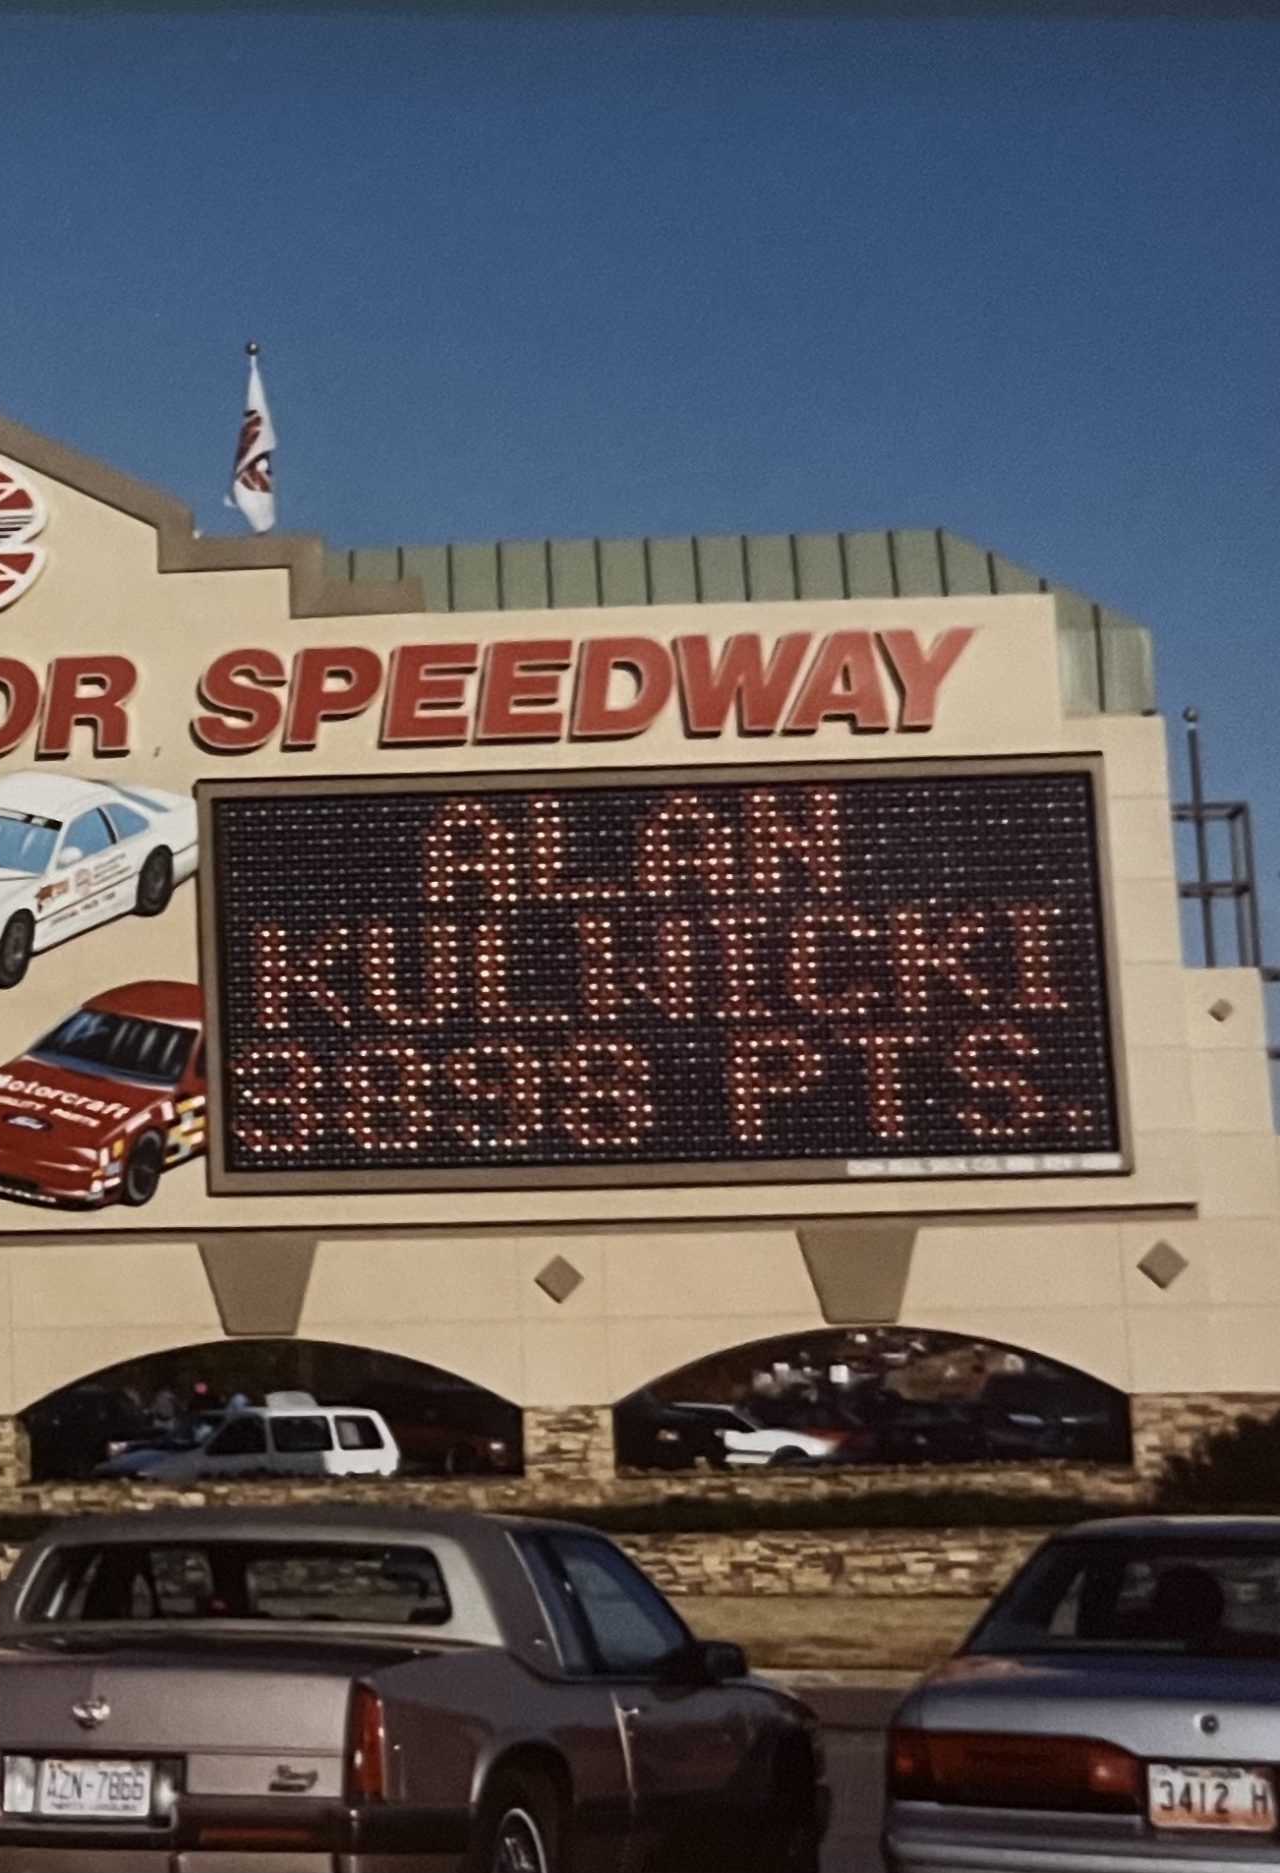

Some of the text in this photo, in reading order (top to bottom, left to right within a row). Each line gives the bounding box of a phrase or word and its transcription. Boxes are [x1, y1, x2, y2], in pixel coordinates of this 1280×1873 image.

[191, 626, 980, 754] SPEEDWAY
[423, 786, 844, 902] ALAN
[230, 1030, 655, 1154] 3898
[1159, 1780, 1229, 1815] 3412
